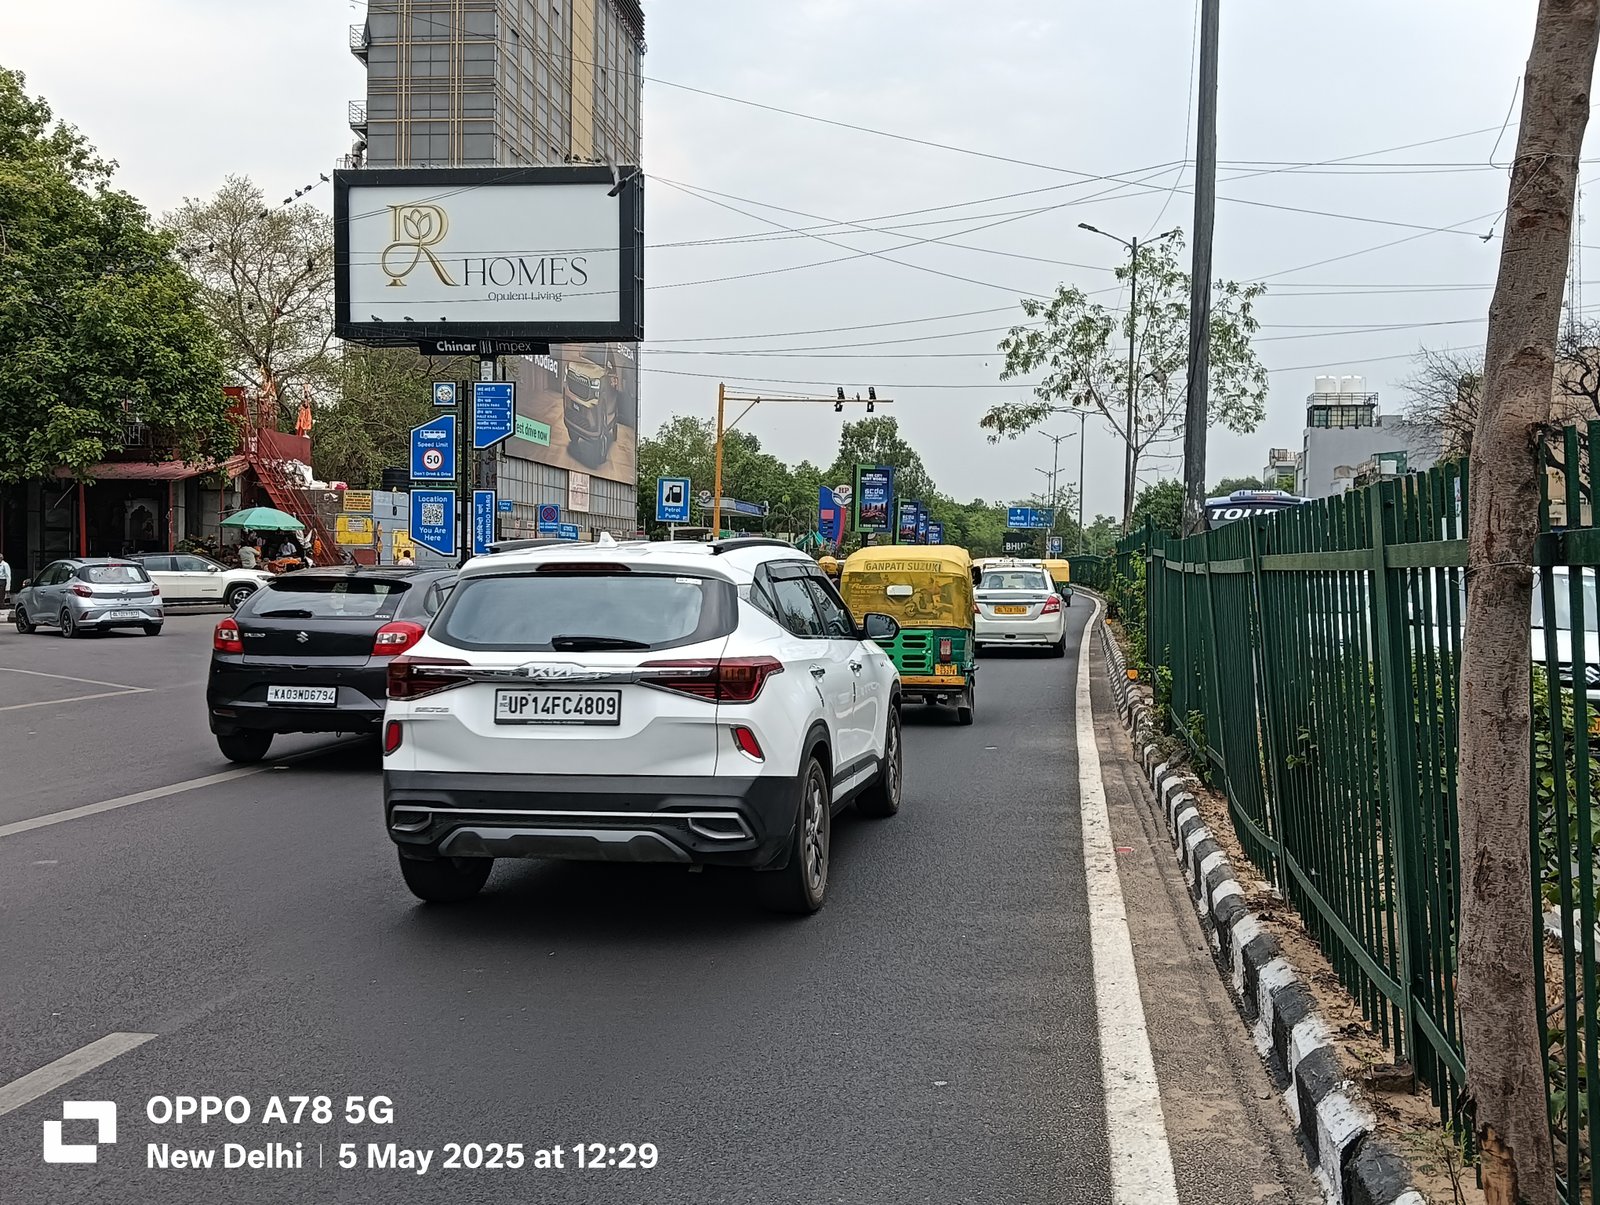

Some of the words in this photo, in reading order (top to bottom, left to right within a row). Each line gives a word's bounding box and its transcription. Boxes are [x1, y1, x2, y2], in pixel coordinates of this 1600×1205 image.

[464, 256, 588, 287] HOMES
[488, 291, 529, 302] Opulent
[530, 291, 562, 302] Living
[436, 341, 477, 352] Chinar
[495, 341, 532, 355] Impex
[525, 424, 537, 437] drive
[537, 430, 548, 441] now
[426, 455, 440, 464] 50
[865, 562, 905, 571] GANPATI
[907, 562, 942, 573] SUZUKI
[508, 695, 616, 715] UP14FC4809
